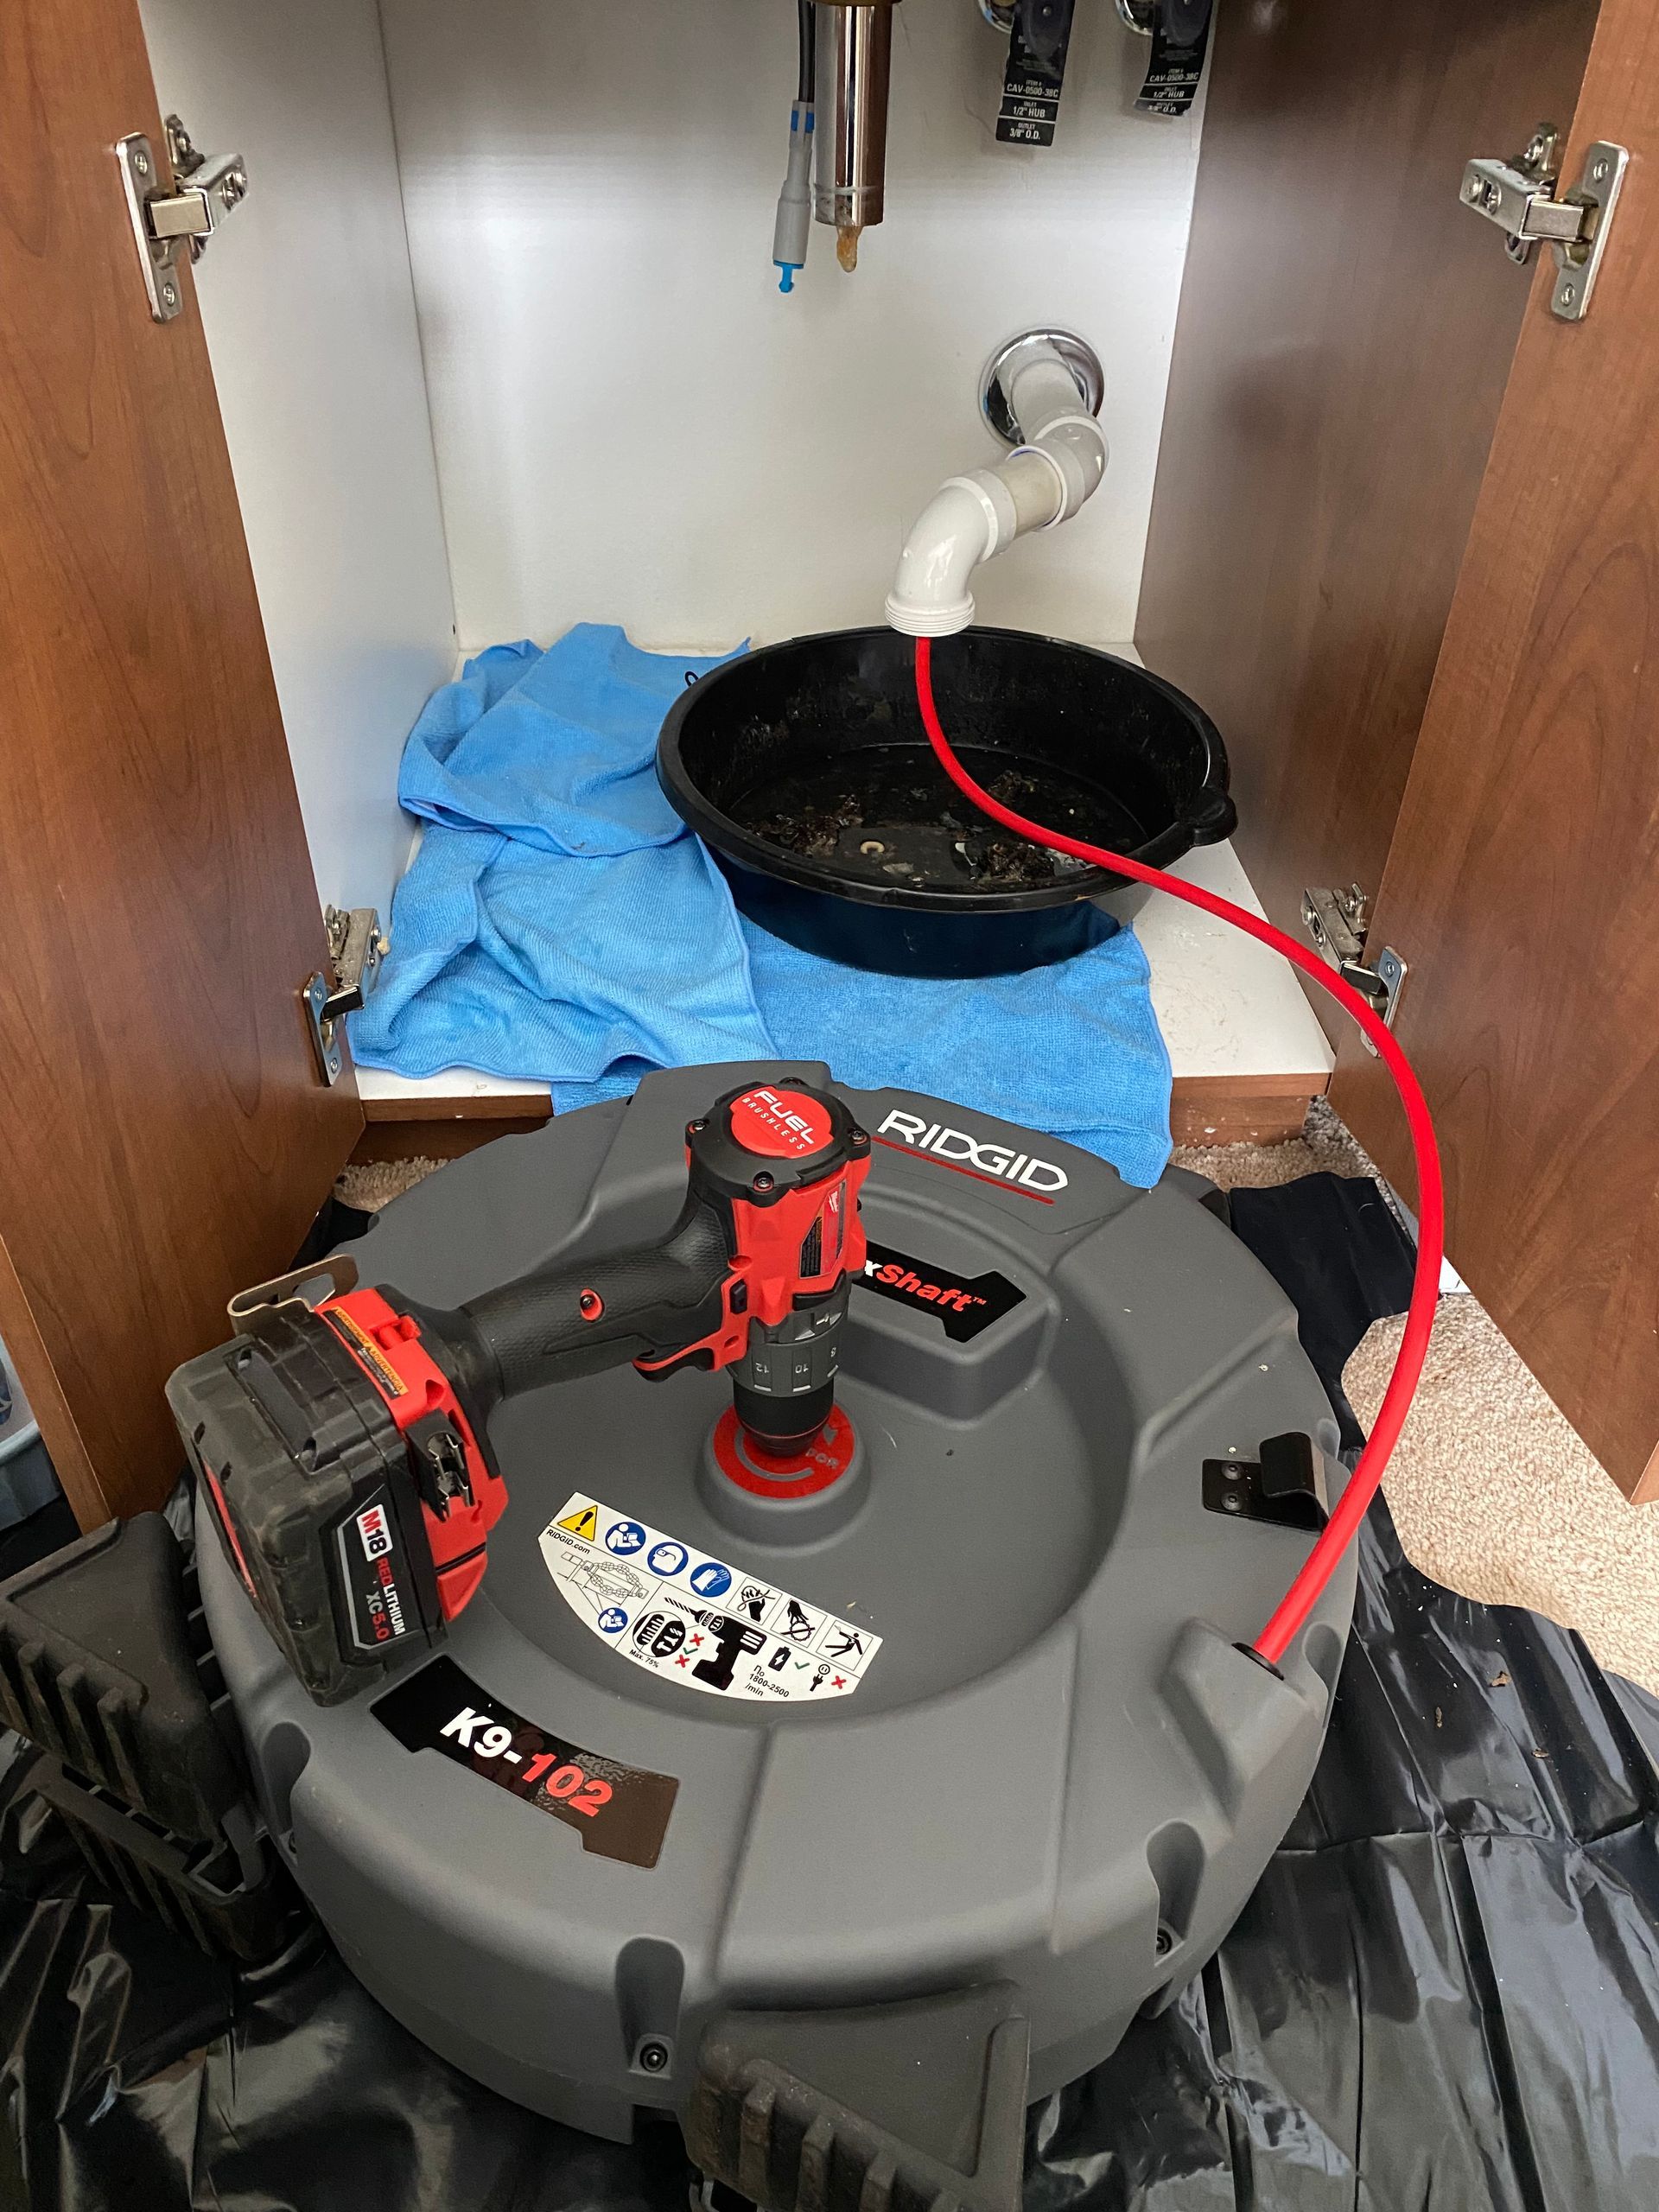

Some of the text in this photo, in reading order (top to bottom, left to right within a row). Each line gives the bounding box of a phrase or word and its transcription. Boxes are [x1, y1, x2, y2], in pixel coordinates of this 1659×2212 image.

[1007, 83, 1058, 98] CAV-0500-38C
[1013, 105, 1046, 118] 1/2" HUB
[1025, 130, 1041, 140] O.D.
[741, 1097, 805, 1150] BRUSHLESS
[753, 1090, 815, 1144] FUEL
[877, 1109, 1069, 1192] RIDGID
[755, 1363, 770, 1375] 12
[795, 1363, 809, 1374] 10
[361, 1510, 387, 1554] M18
[546, 1529, 591, 1554] RIDGID.com
[377, 1556, 406, 1637] REDLITHIUM
[366, 1590, 390, 1641] XC5.0
[629, 1649, 660, 1669] Max. 75%
[745, 1682, 764, 1697] /min
[749, 1673, 790, 1698] 1800-2500
[439, 1707, 613, 1817] K9-102
